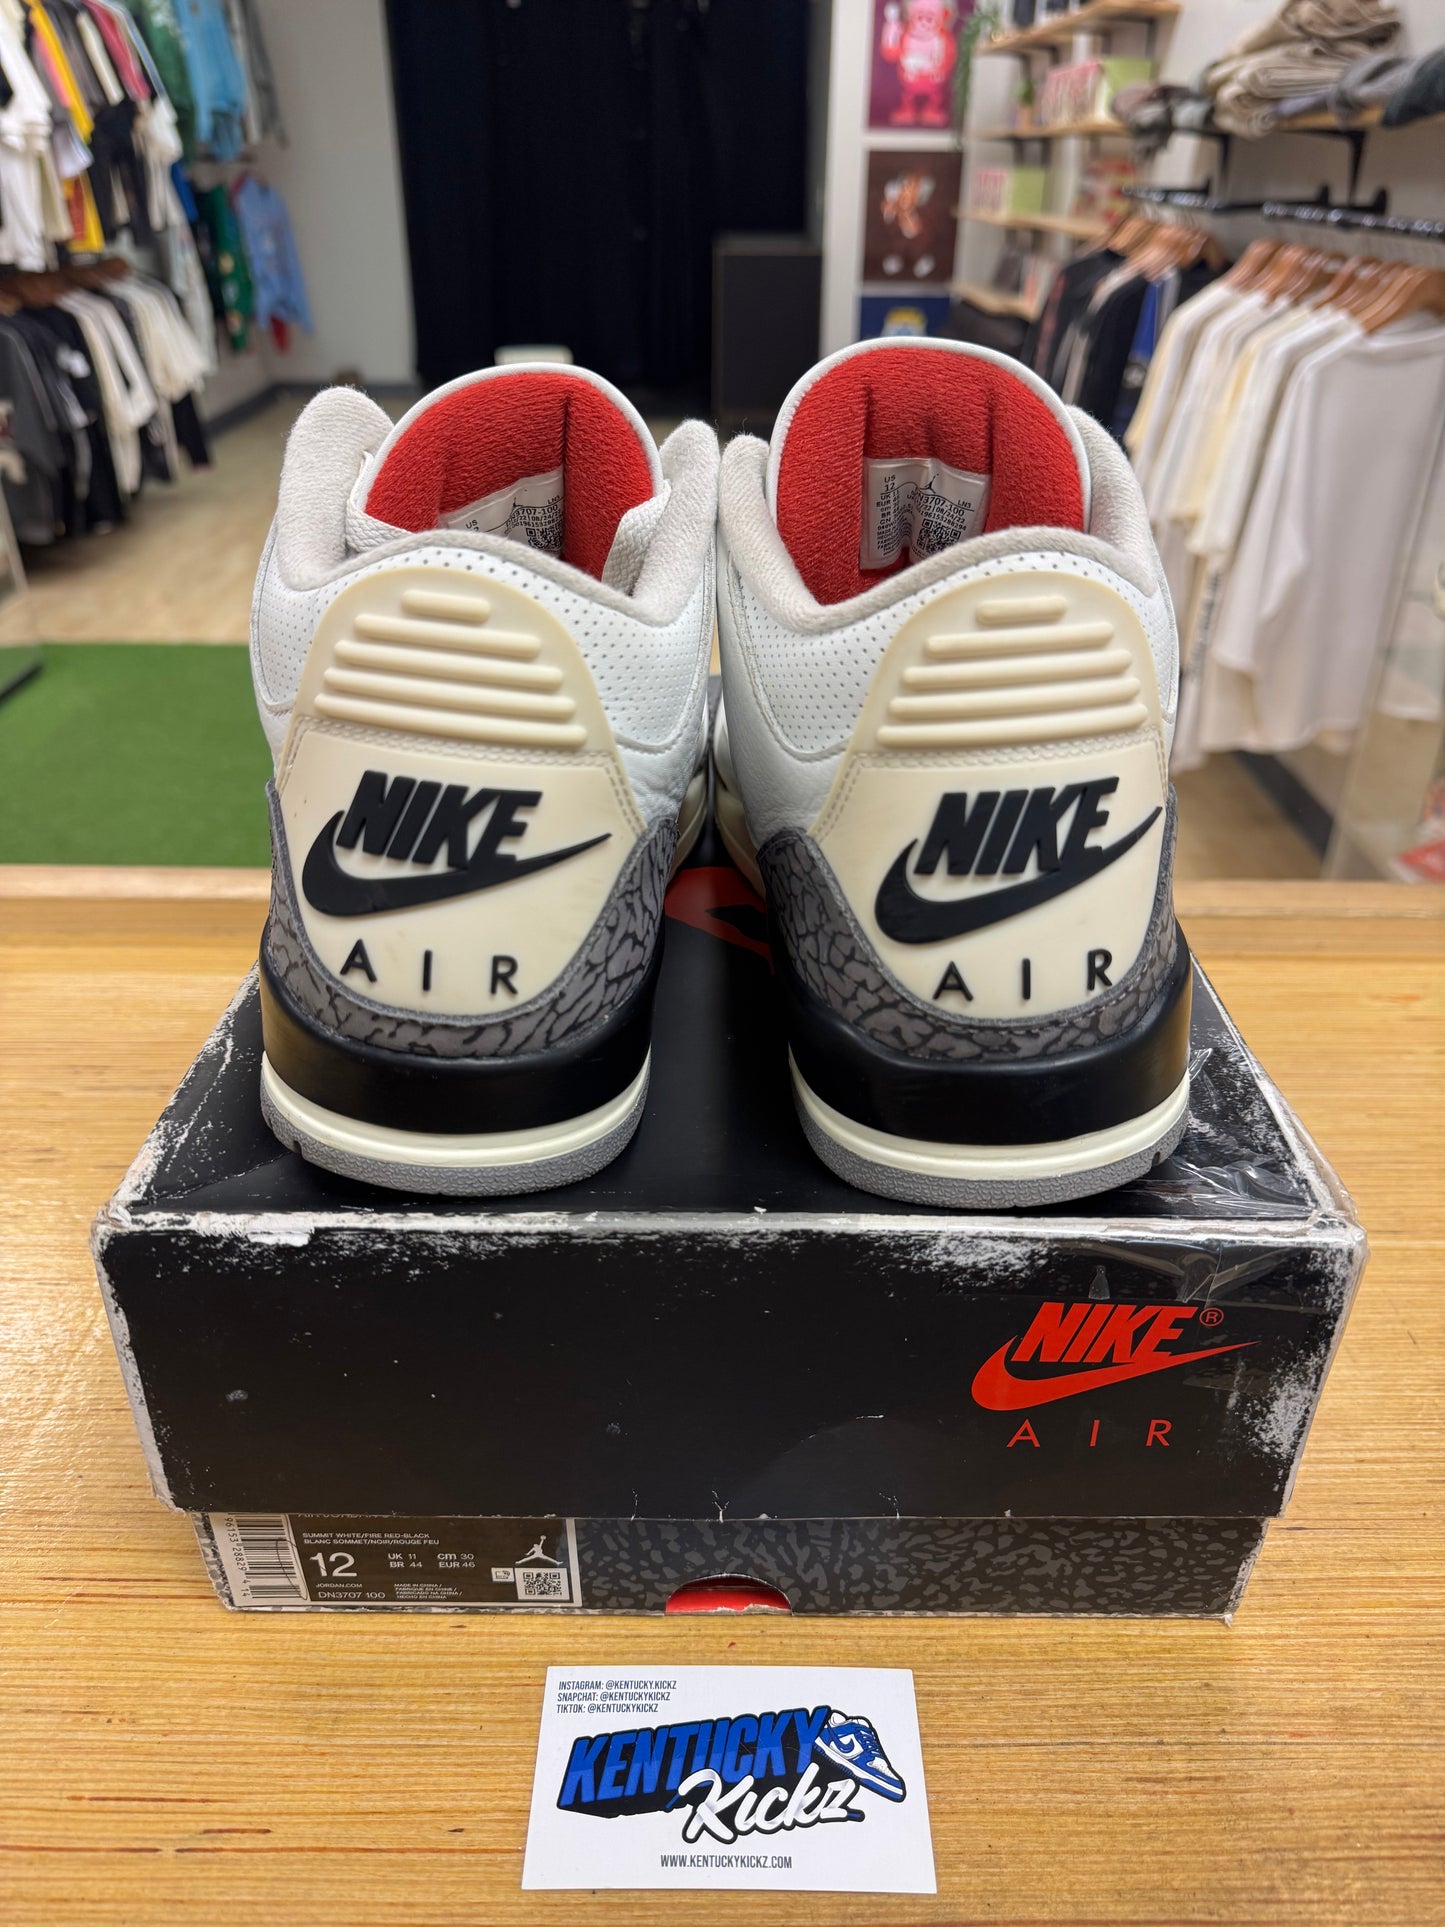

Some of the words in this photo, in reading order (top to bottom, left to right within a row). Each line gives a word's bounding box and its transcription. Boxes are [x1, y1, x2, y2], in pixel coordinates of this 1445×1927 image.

[884, 475, 896, 483] US
[884, 483, 895, 491] 12
[464, 519, 478, 530] US
[336, 769, 543, 871] NIKE
[913, 776, 1120, 876] NIKE
[340, 938, 518, 995] AIR
[933, 948, 1113, 1001] AIR
[1006, 1418, 1172, 1448] AIR
[309, 1552, 357, 1577] 12
[318, 1591, 362, 1599] DN3707
[366, 1591, 386, 1599] 100
[558, 1680, 605, 1690] INSTAGRAM:
[605, 1680, 677, 1690] @KENTUCKY.KICKZ
[557, 1692, 599, 1702] SNAPCHAT:
[600, 1691, 671, 1702] @KENTUCKYKICKZ
[556, 1704, 586, 1713] TIKTOK:
[587, 1703, 659, 1714] @KENTUCKYKICKZ
[558, 1706, 830, 1810] KENTUCKY
[677, 1763, 856, 1842] Kickz
[660, 1854, 793, 1869] WWW.KENTUCKYKICKZ.COM
